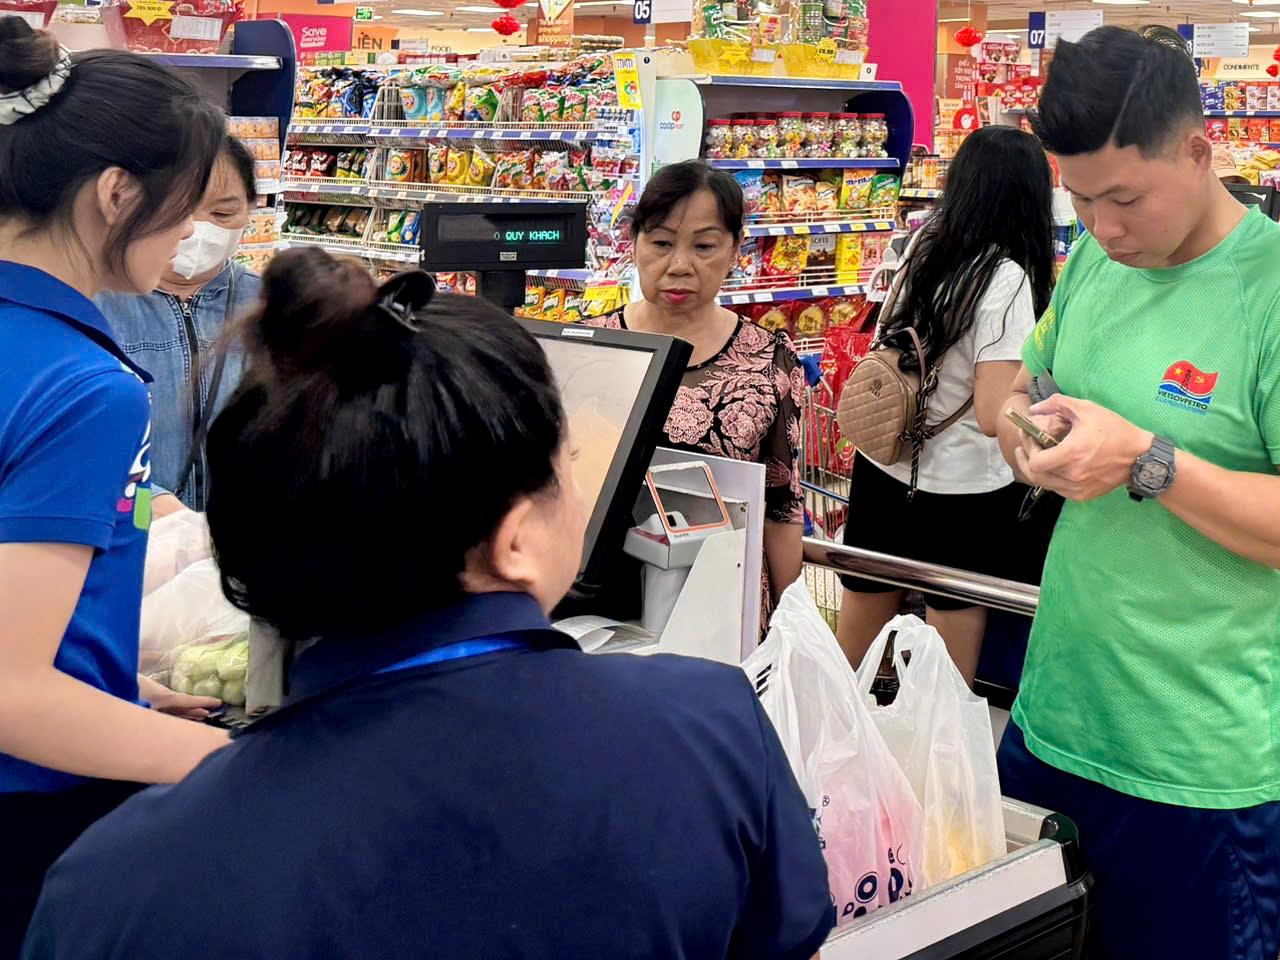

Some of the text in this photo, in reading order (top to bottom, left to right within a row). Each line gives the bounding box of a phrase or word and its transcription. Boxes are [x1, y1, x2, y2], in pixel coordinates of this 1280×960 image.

[635, 0, 650, 19] 05
[302, 26, 328, 36] Save
[1030, 30, 1045, 45] 07
[505, 231, 524, 241] QUY
[529, 230, 560, 240] KHACH
